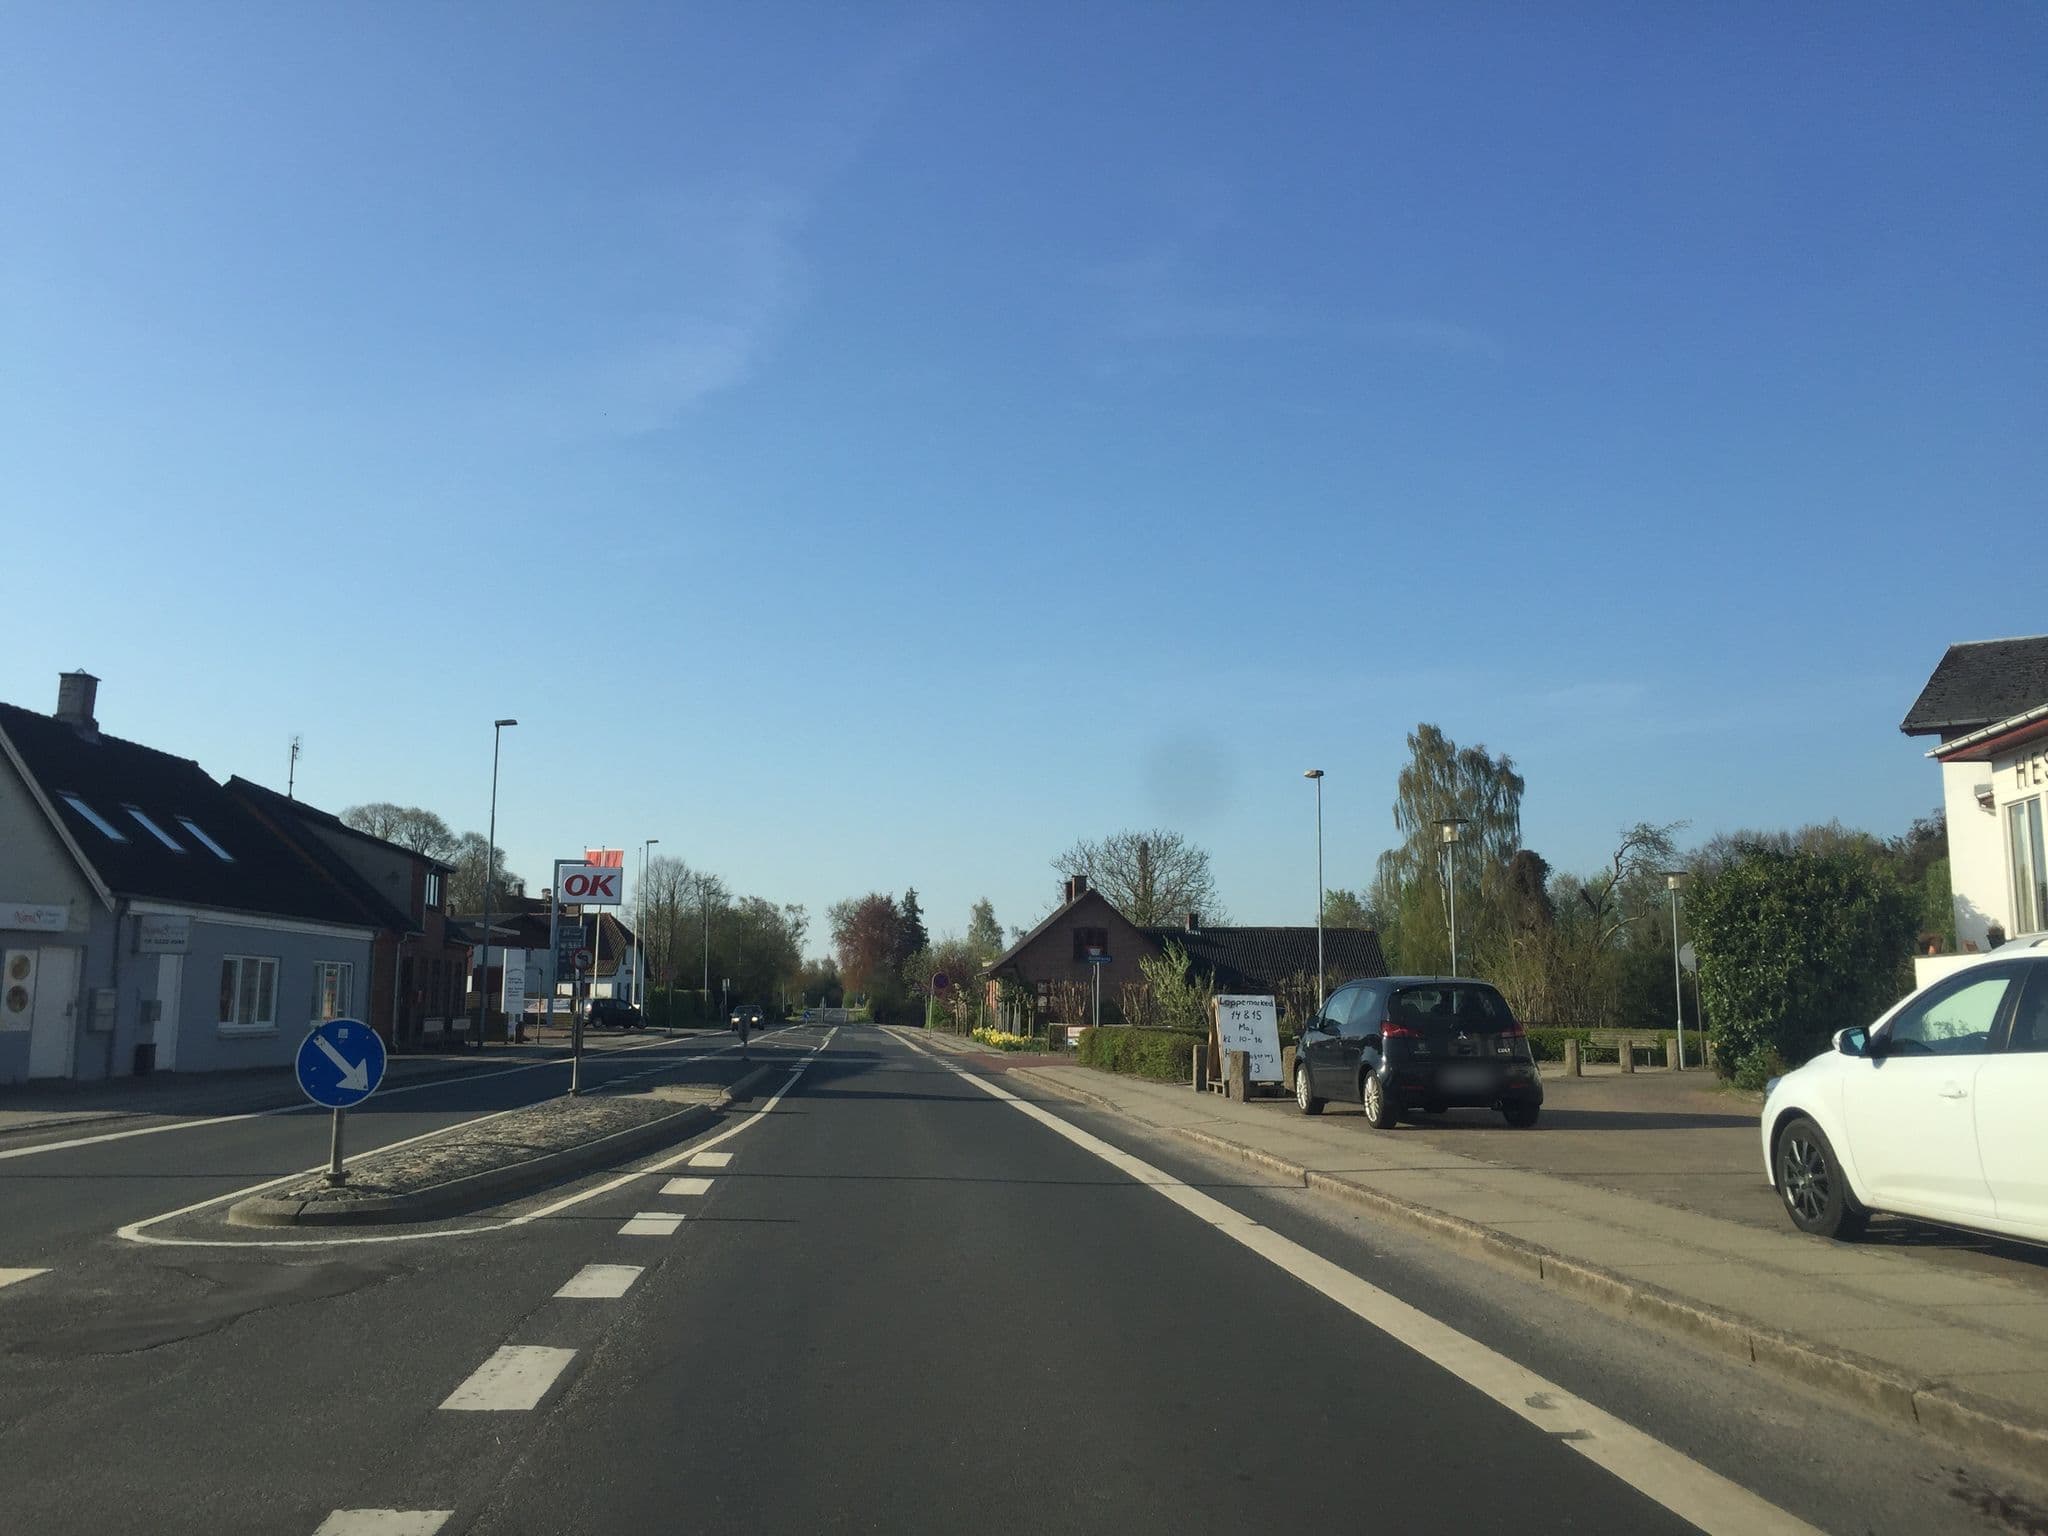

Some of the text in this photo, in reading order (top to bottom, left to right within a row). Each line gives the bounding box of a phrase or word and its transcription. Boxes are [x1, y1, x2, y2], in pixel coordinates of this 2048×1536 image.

[564, 874, 616, 897] OK
[1219, 997, 1274, 1008] Loppemarked
[1231, 1010, 1241, 1020] 14
[1252, 1010, 1262, 1021] 15
